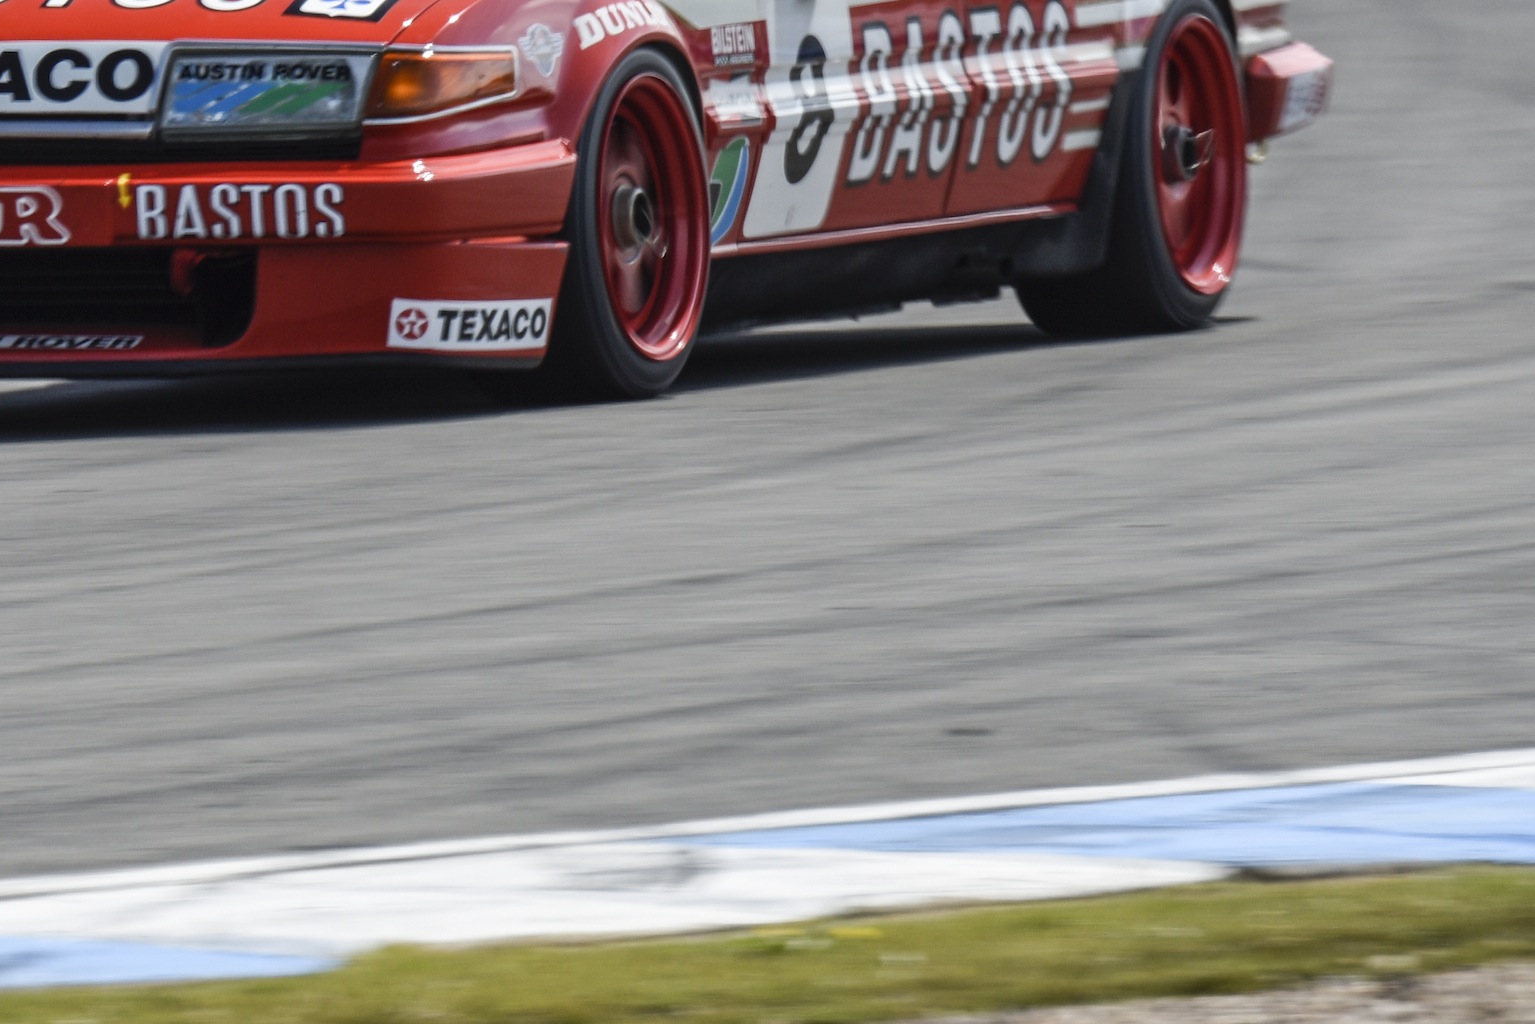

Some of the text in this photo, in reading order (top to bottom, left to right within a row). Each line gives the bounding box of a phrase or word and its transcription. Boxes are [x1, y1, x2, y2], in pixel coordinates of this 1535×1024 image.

[711, 23, 756, 56] BILSTEIN
[178, 63, 352, 81] AUSTIN ROVER
[783, 33, 835, 184] 8
[136, 182, 346, 239] BASTOS
[437, 306, 547, 342] TEXACO
[10, 335, 140, 349] ROVER
